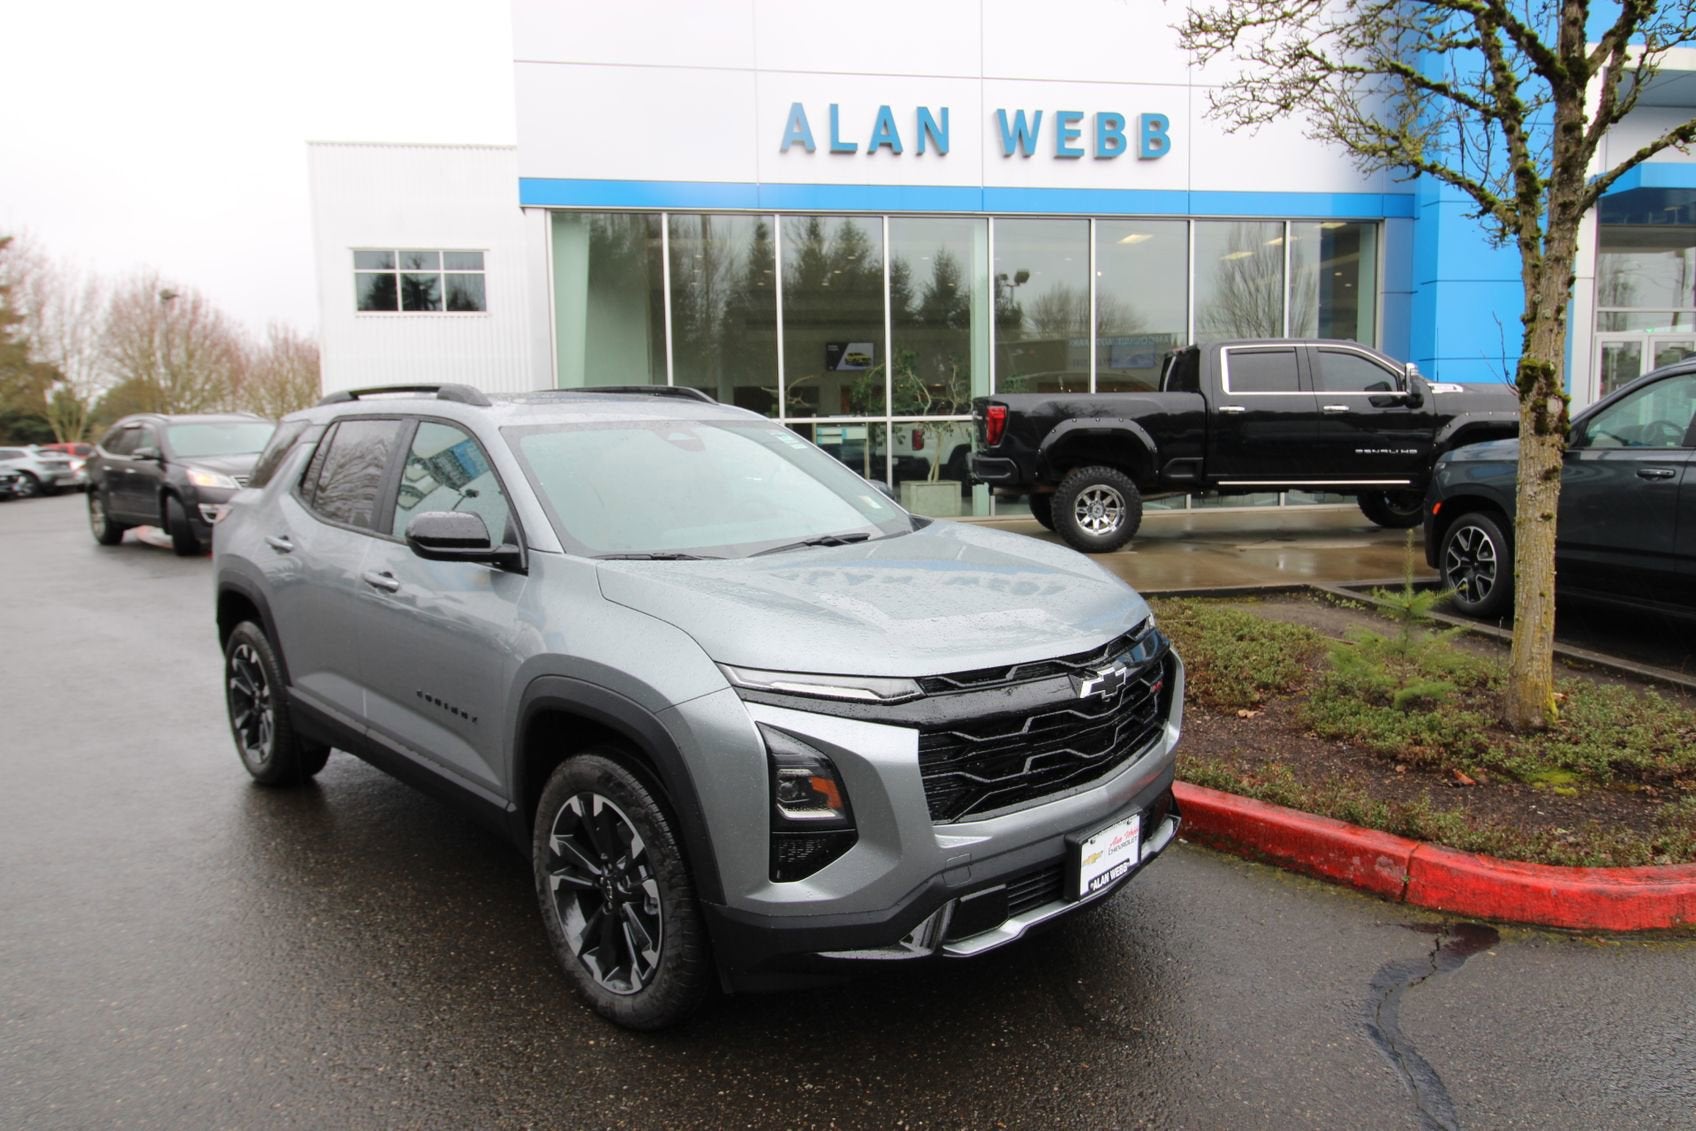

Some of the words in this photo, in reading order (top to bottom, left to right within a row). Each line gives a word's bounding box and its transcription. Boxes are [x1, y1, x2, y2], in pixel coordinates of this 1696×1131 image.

[780, 102, 949, 156] ALAN
[996, 108, 1172, 160] WEBB
[1108, 836, 1137, 856] CHEVROLET
